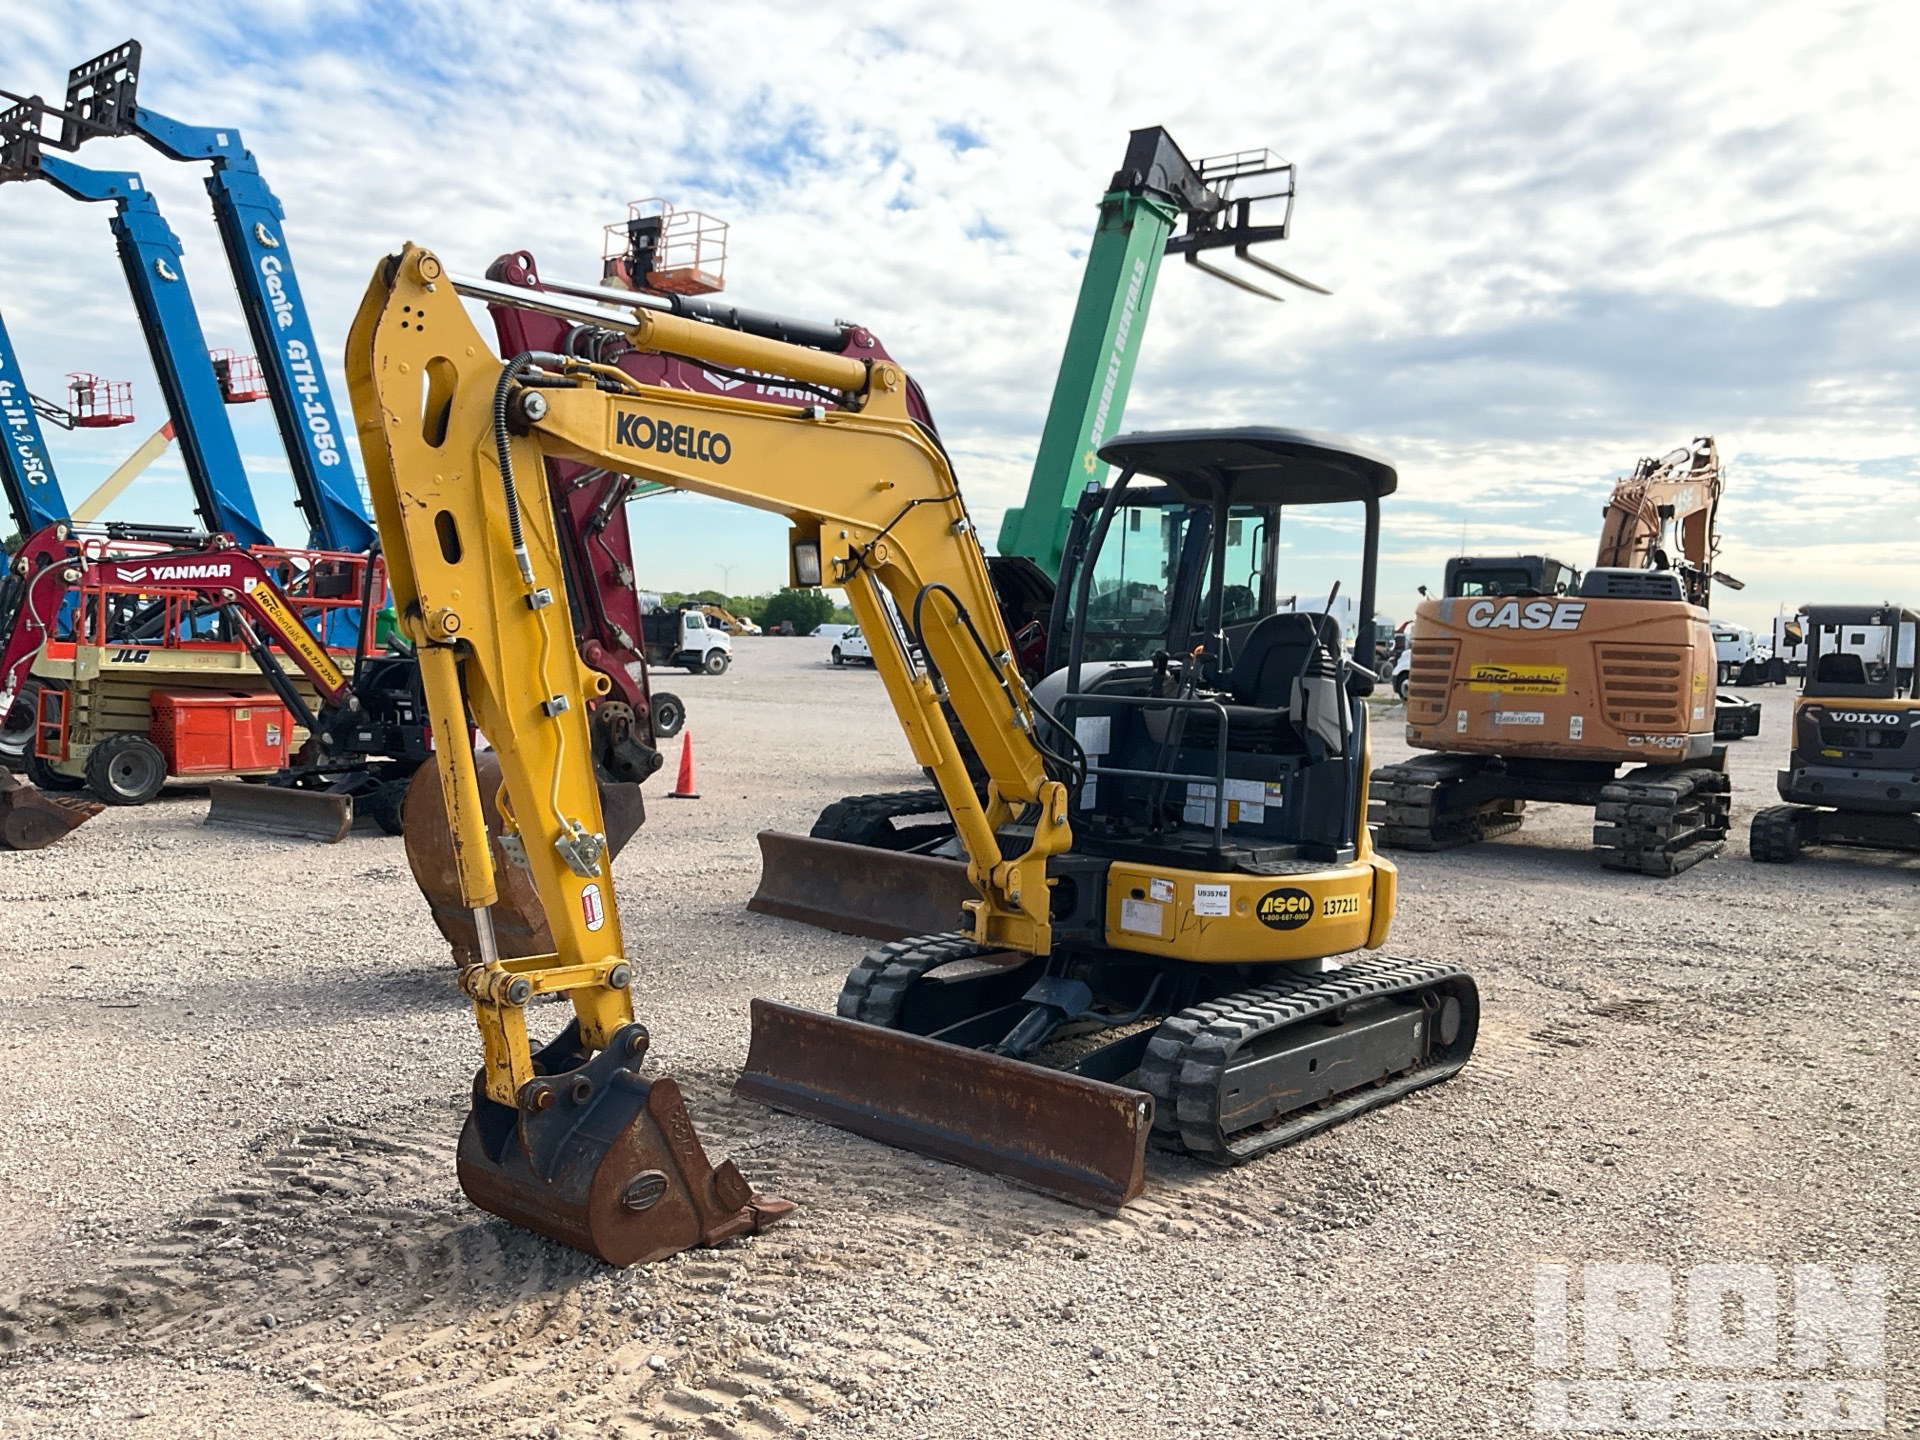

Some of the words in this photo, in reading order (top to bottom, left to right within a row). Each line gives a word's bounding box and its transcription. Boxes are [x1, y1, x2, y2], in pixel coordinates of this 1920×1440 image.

[261, 255, 293, 331] Genie
[288, 339, 340, 467] GTH-1056
[1090, 349, 1122, 448] SUNBELT
[1114, 257, 1145, 353] RENTALS
[616, 411, 731, 464] KOBELCO
[150, 564, 231, 580] YANMAR
[1467, 600, 1587, 630] CASE
[257, 591, 301, 642] HercRentals
[299, 643, 337, 686] 888-777-2700
[111, 649, 150, 663] JLG
[1829, 711, 1900, 725] VOLVO
[1197, 889, 1228, 897] U935762
[1260, 896, 1311, 913] ASCO
[1323, 897, 1358, 916] 137211
